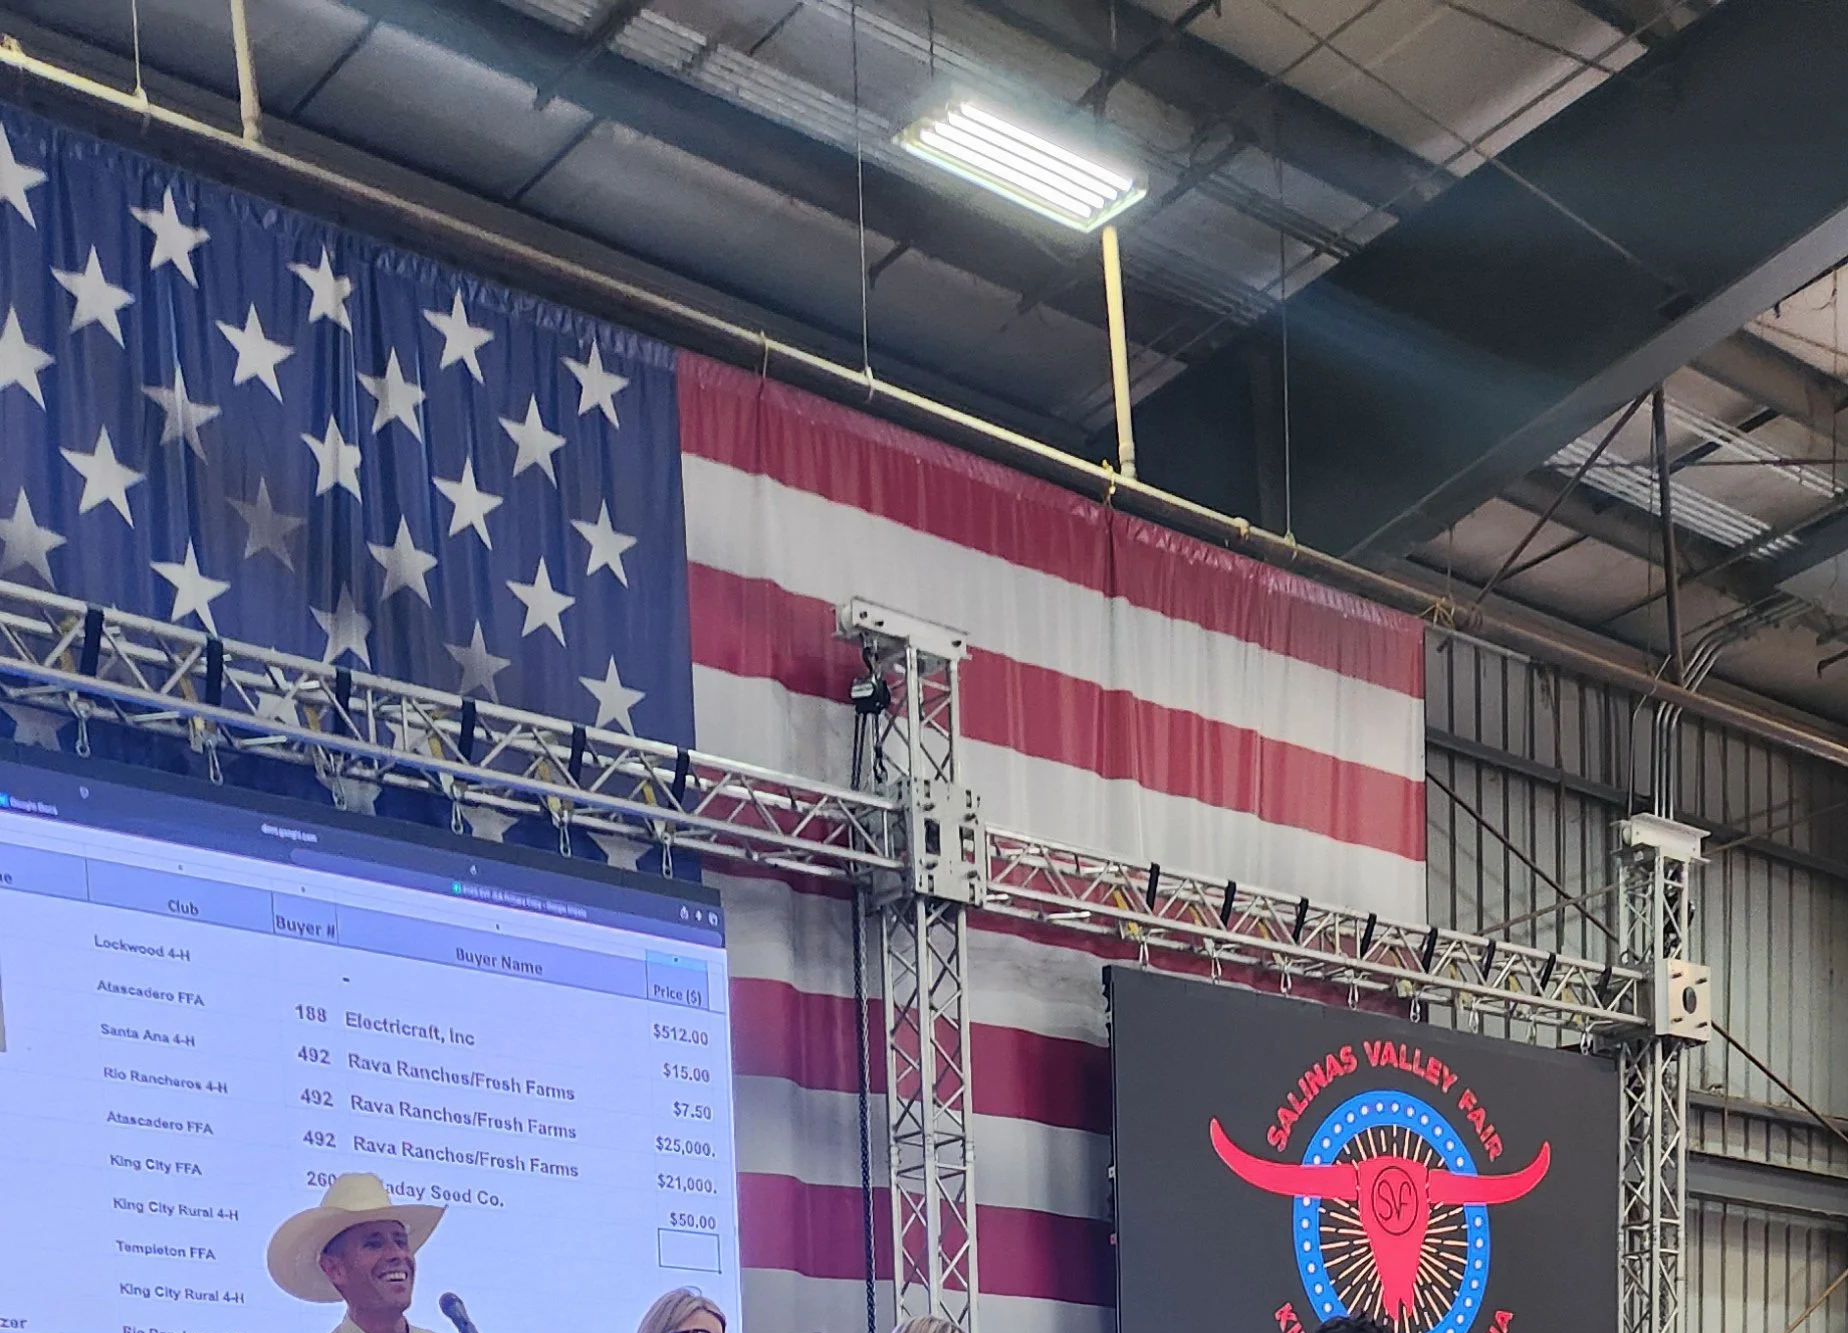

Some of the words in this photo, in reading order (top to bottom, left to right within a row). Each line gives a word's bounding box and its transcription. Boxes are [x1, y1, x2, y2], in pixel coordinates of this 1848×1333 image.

[168, 899, 199, 916] Club
[276, 915, 321, 937] Buyer
[94, 934, 164, 958] Lockwood
[168, 948, 190, 962] 4-H
[456, 948, 497, 969] Buyer
[501, 955, 543, 975] Name
[97, 980, 174, 1003] Atascadero
[178, 991, 204, 1006] FFA
[653, 984, 683, 1001] Price
[295, 1004, 327, 1023] 188
[100, 1023, 139, 1040] Santa
[143, 1029, 169, 1043] Ana
[172, 1034, 195, 1048] 4-H
[346, 1012, 445, 1044] Electricraft,
[449, 1028, 475, 1046] Inc
[653, 1023, 709, 1047] $512.00
[297, 1046, 331, 1065] 492
[104, 1066, 126, 1081] Rio
[130, 1070, 202, 1090] Rancheros
[205, 1080, 228, 1094] 4-H
[348, 1053, 392, 1076] Rava
[397, 1060, 521, 1093] Ranches/Fresh
[526, 1079, 575, 1100] Farms
[663, 1062, 710, 1083] $15.00
[300, 1088, 334, 1107] 492
[1266, 1045, 1358, 1152] SALINAS
[1363, 1040, 1458, 1095] VALLEY
[1457, 1088, 1505, 1162] FAIR
[351, 1095, 395, 1116] Rava
[400, 1101, 523, 1133] Ranches/Fresh
[528, 1119, 577, 1139] Farms
[673, 1101, 712, 1120] $7.50
[107, 1110, 183, 1132] Atascadero
[187, 1120, 214, 1135] FFA
[303, 1130, 336, 1148] 492
[110, 1155, 141, 1171] King
[145, 1158, 172, 1175] City
[175, 1161, 202, 1176] FFA
[353, 1136, 397, 1156] Rava
[402, 1141, 525, 1172] Ranches/Fresh
[530, 1158, 579, 1178] Farms
[306, 1171, 337, 1187] 260
[385, 1181, 425, 1200] aday
[431, 1184, 472, 1203] Seed
[477, 1190, 504, 1207] Co.
[113, 1198, 145, 1214] King
[148, 1201, 175, 1217] City
[178, 1203, 214, 1219] Rural
[217, 1207, 239, 1221] 4-H
[670, 1211, 716, 1230] $50.00
[116, 1240, 186, 1259] Templeton
[189, 1247, 216, 1260] FFA
[120, 1283, 151, 1300] King
[154, 1286, 181, 1302] City
[184, 1288, 219, 1302] Rural
[222, 1291, 245, 1304] 4-H
